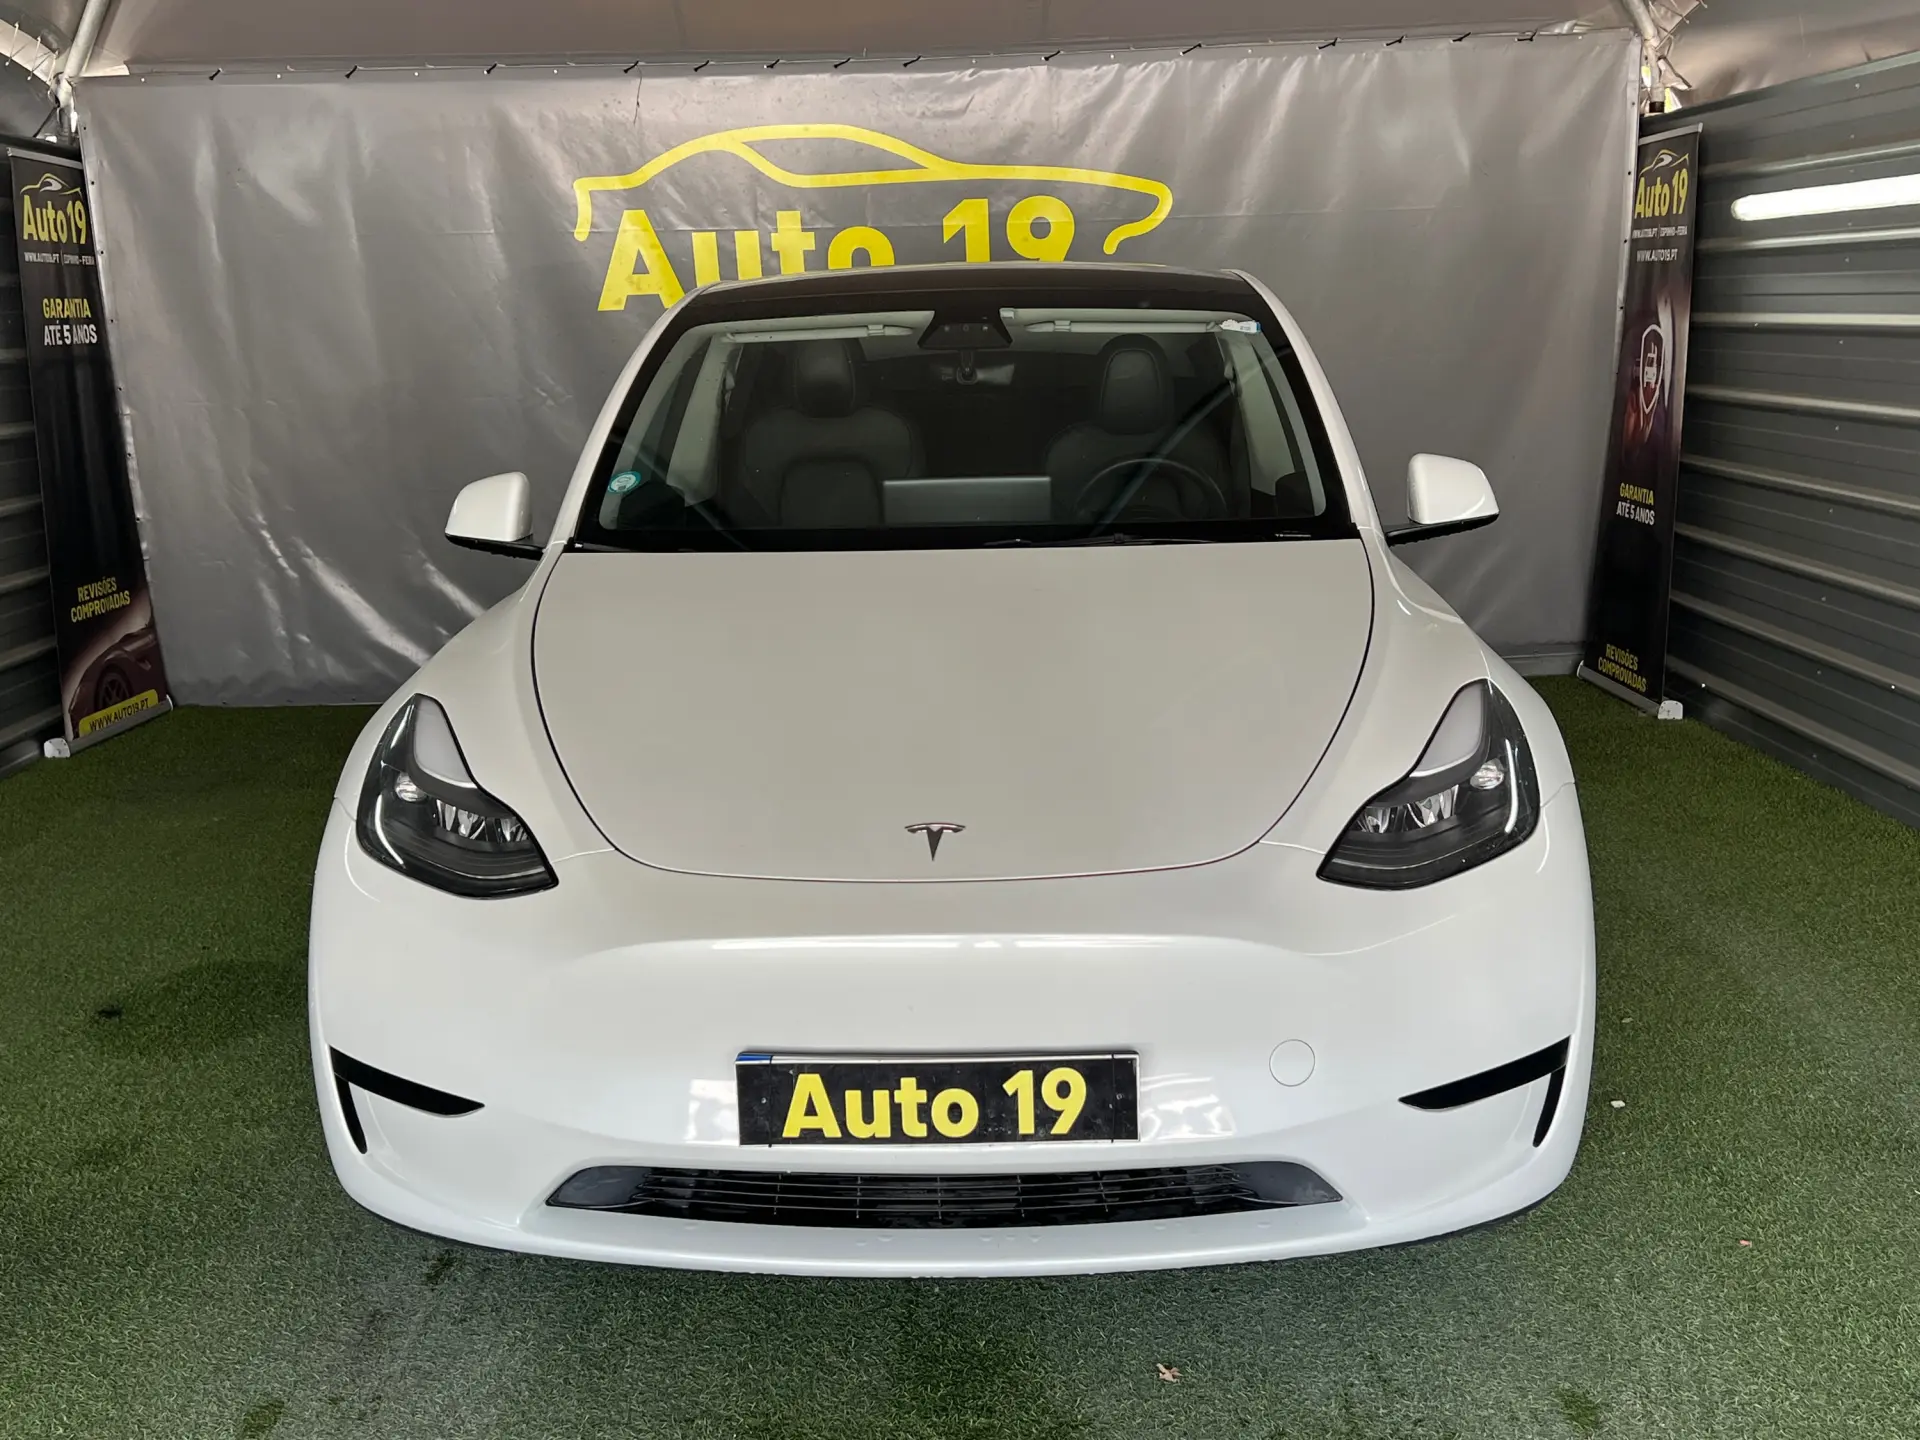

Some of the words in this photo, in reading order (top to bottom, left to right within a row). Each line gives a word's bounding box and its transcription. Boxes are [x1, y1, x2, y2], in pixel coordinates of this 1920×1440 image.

[1634, 177, 1670, 219] Auto
[1672, 168, 1688, 215] 19
[23, 194, 67, 243] Auto
[67, 200, 87, 244] 19
[597, 209, 895, 312] Auto
[942, 195, 1075, 263] 19
[42, 298, 91, 319] GARANTIA
[44, 320, 63, 346] ATÉ
[63, 324, 71, 345] 5
[73, 324, 98, 345] ANOS
[1619, 482, 1654, 505] GARANTIA
[1616, 500, 1630, 518] ATÉ
[1629, 504, 1635, 519] 5
[1635, 505, 1655, 526] ANOS
[77, 576, 117, 603] REVISÕES
[70, 590, 131, 623] COMPROVADAS
[1606, 643, 1639, 671] REVISÕES
[1598, 656, 1647, 693] COMPROVADAS
[89, 697, 149, 732] WWW.AUTO19.PT
[781, 1073, 979, 1139] Auto
[1002, 1067, 1087, 1136] 19
